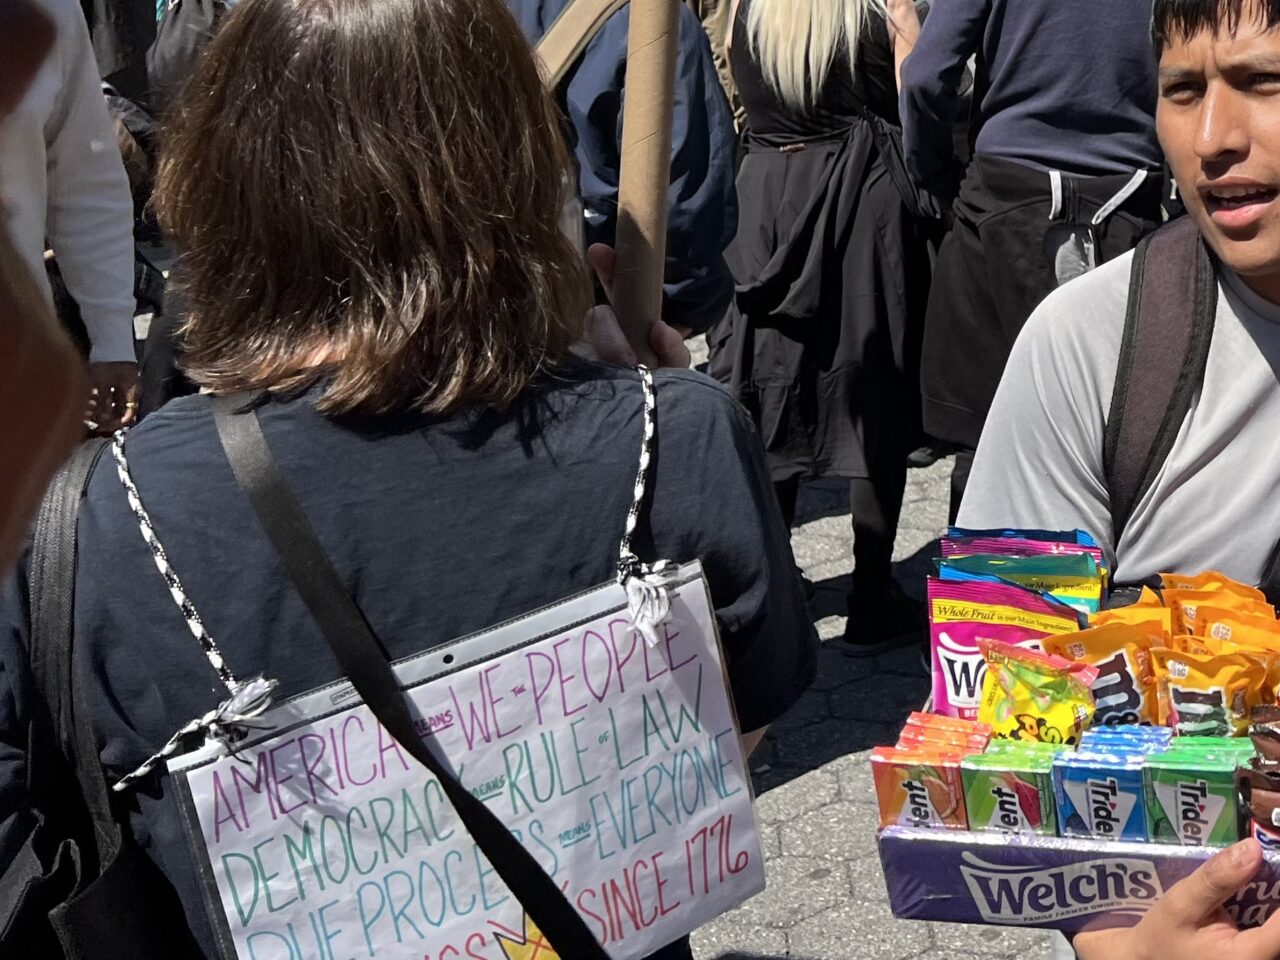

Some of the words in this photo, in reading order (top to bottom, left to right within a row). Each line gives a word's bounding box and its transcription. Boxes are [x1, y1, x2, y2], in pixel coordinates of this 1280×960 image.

[938, 605, 968, 618] Whole
[971, 608, 996, 621] Fruit
[212, 714, 410, 844] AMERICA
[448, 663, 523, 751] WE
[525, 618, 699, 726] PEOPLE
[221, 762, 465, 928] DEMOCRAC
[502, 717, 602, 816] RULE
[598, 730, 609, 744] OF
[608, 663, 703, 771] LAW
[588, 728, 742, 860] EVERYONE
[576, 851, 681, 947] SINCE
[684, 813, 749, 896] 1776
[969, 863, 1153, 916] Welch's
